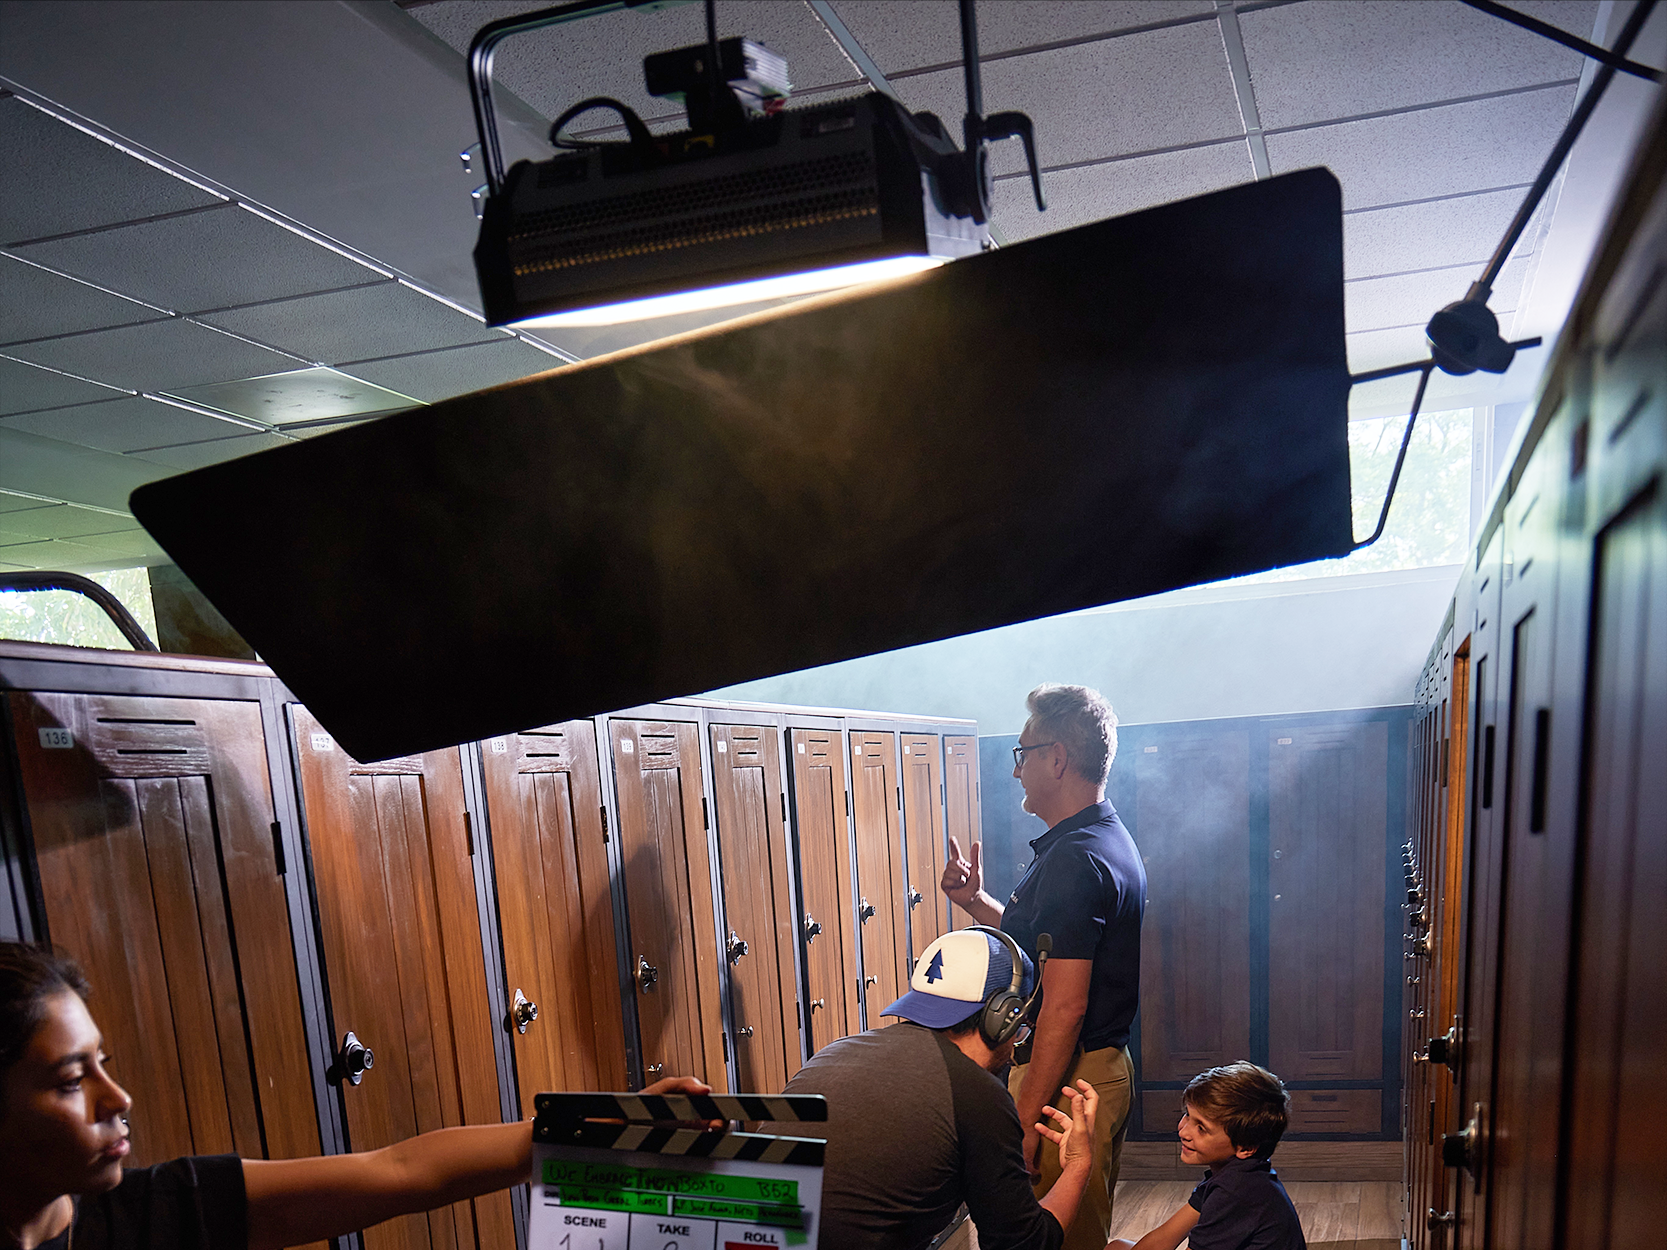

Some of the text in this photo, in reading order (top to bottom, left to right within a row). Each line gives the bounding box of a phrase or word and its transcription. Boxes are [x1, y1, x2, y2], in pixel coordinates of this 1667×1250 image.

[45, 732, 68, 745] 136
[564, 1215, 607, 1229] SCENE
[657, 1223, 691, 1236] TAKE
[744, 1231, 779, 1244] ROLL
